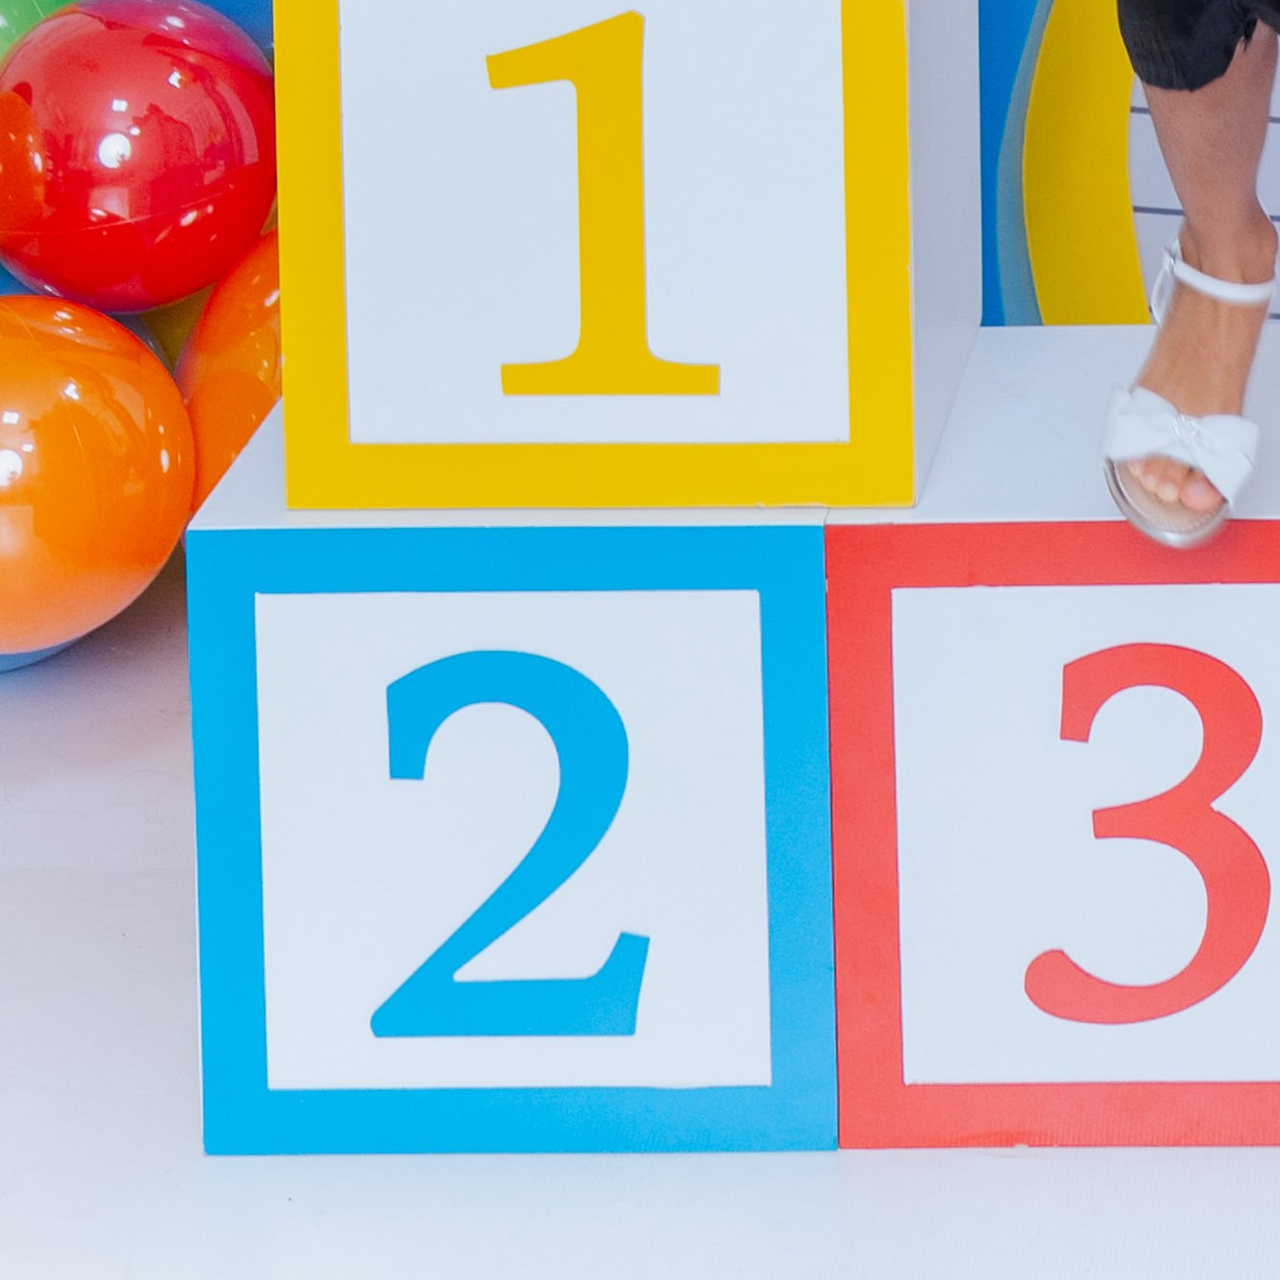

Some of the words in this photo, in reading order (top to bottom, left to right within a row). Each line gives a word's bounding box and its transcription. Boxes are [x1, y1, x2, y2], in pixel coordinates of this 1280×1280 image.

[486, 10, 720, 396] 1
[370, 649, 651, 1039] 2
[1025, 642, 1271, 1024] 3
